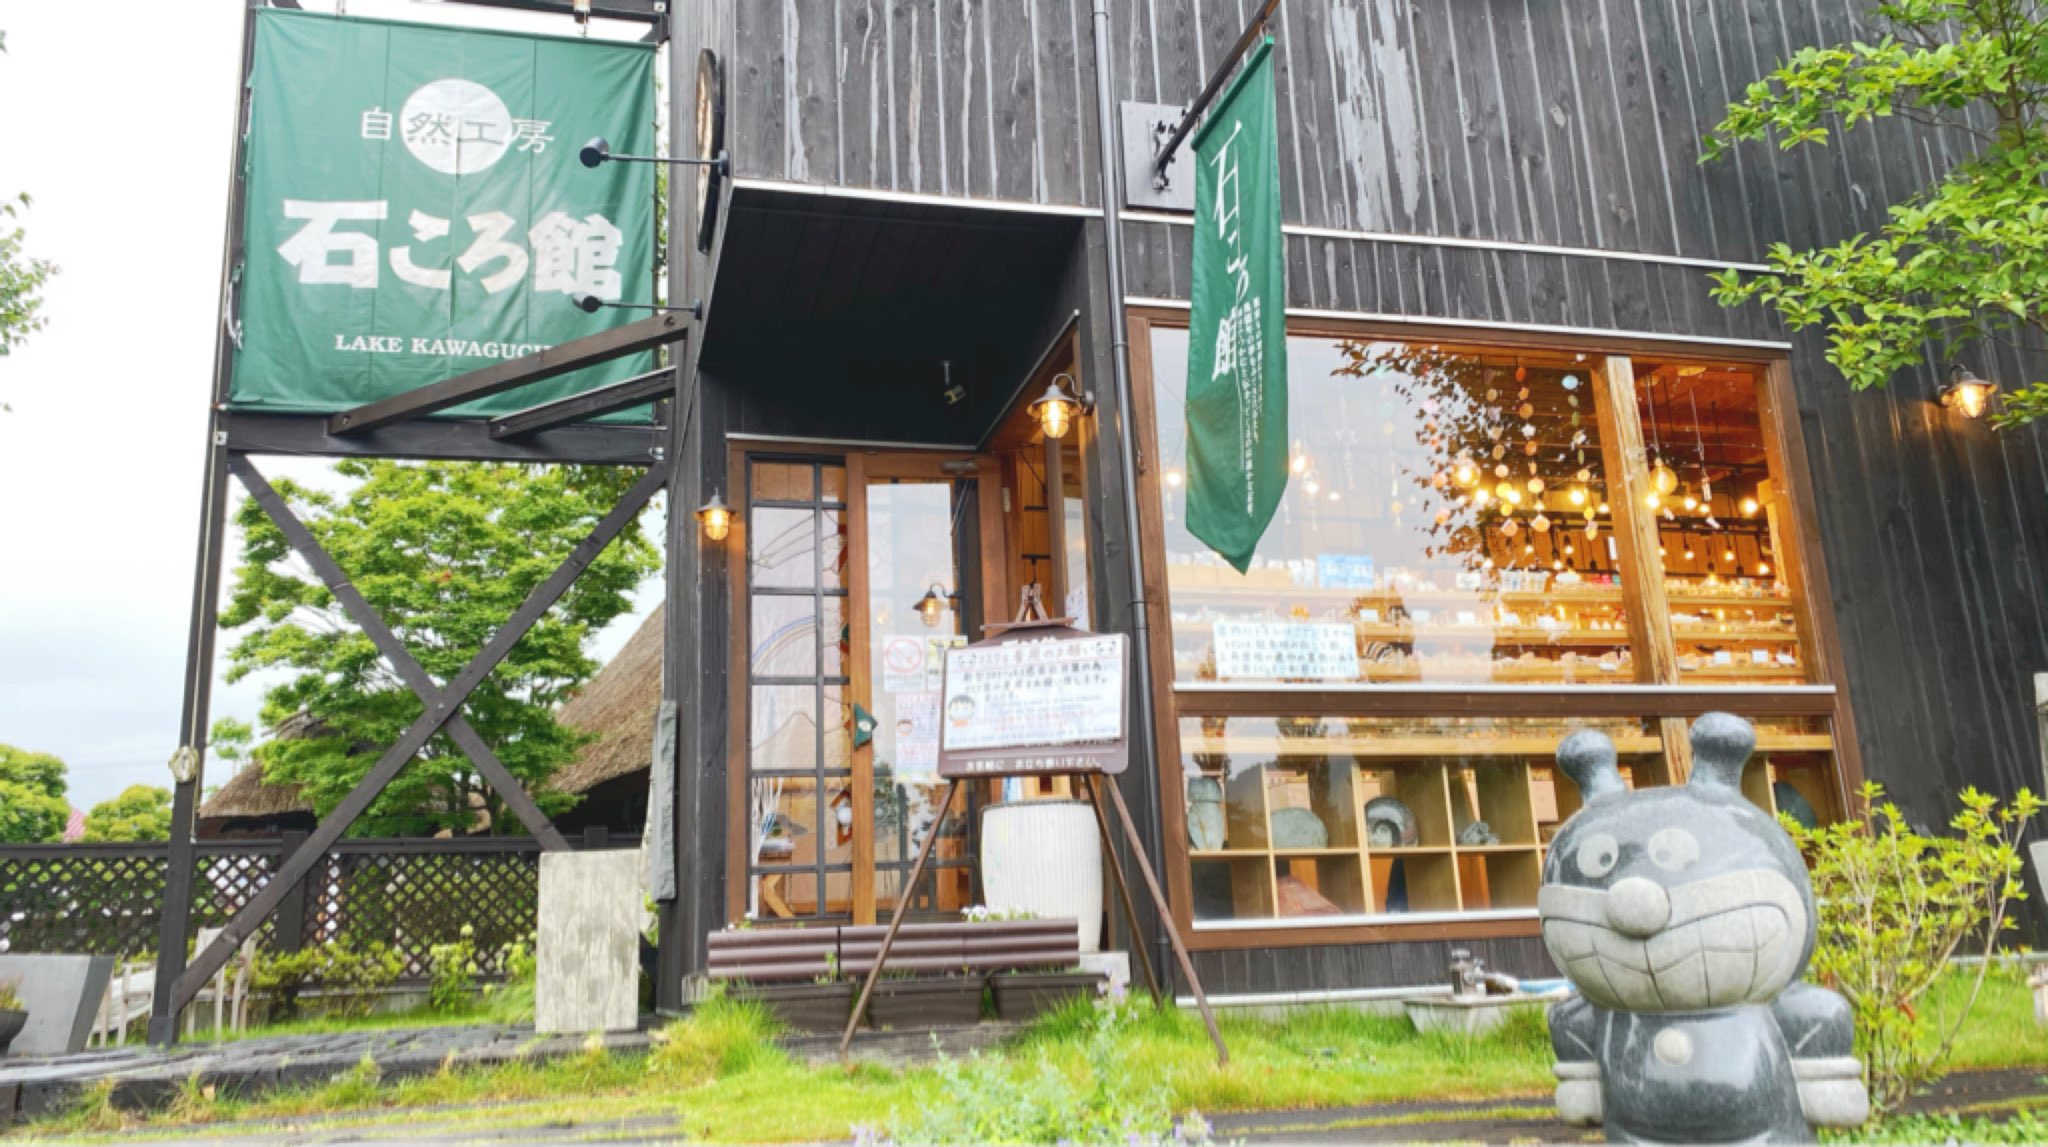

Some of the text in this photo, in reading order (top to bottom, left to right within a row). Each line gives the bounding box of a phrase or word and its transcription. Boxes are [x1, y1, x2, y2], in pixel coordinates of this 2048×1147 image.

[360, 105, 555, 154] 自然工房
[277, 199, 624, 300] 石ころ館
[335, 334, 403, 353] LAKE
